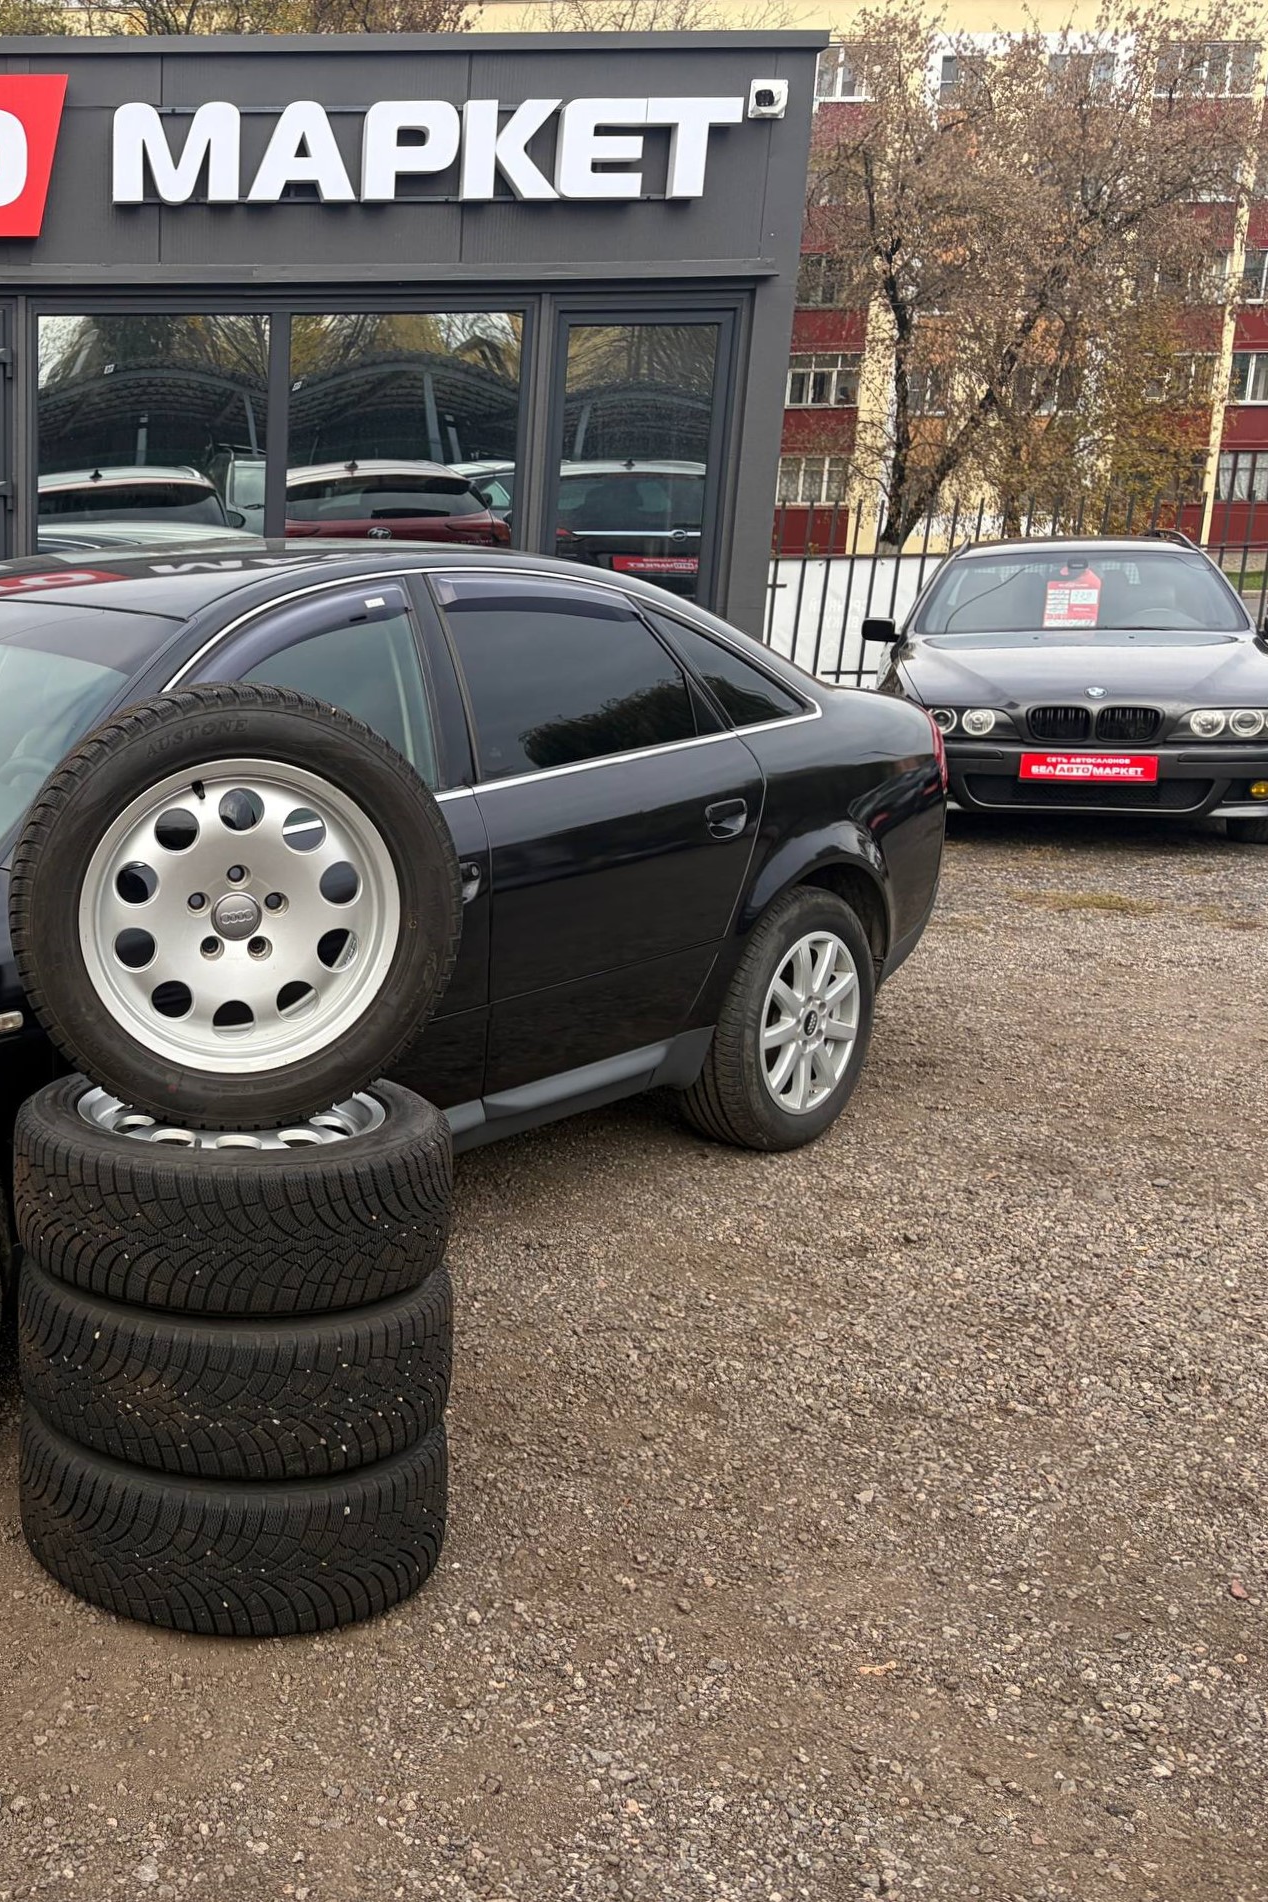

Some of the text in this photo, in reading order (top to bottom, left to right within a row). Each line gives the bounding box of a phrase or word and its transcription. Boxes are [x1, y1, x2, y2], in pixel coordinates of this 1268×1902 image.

[112, 96, 744, 204] МАРКЕТ
[147, 719, 249, 758] AUSTONE
[1031, 765, 1144, 776] БЕЛ АВТО МАРКЕТ
[1070, 757, 1131, 765] АВТОСАЛОНОВ
